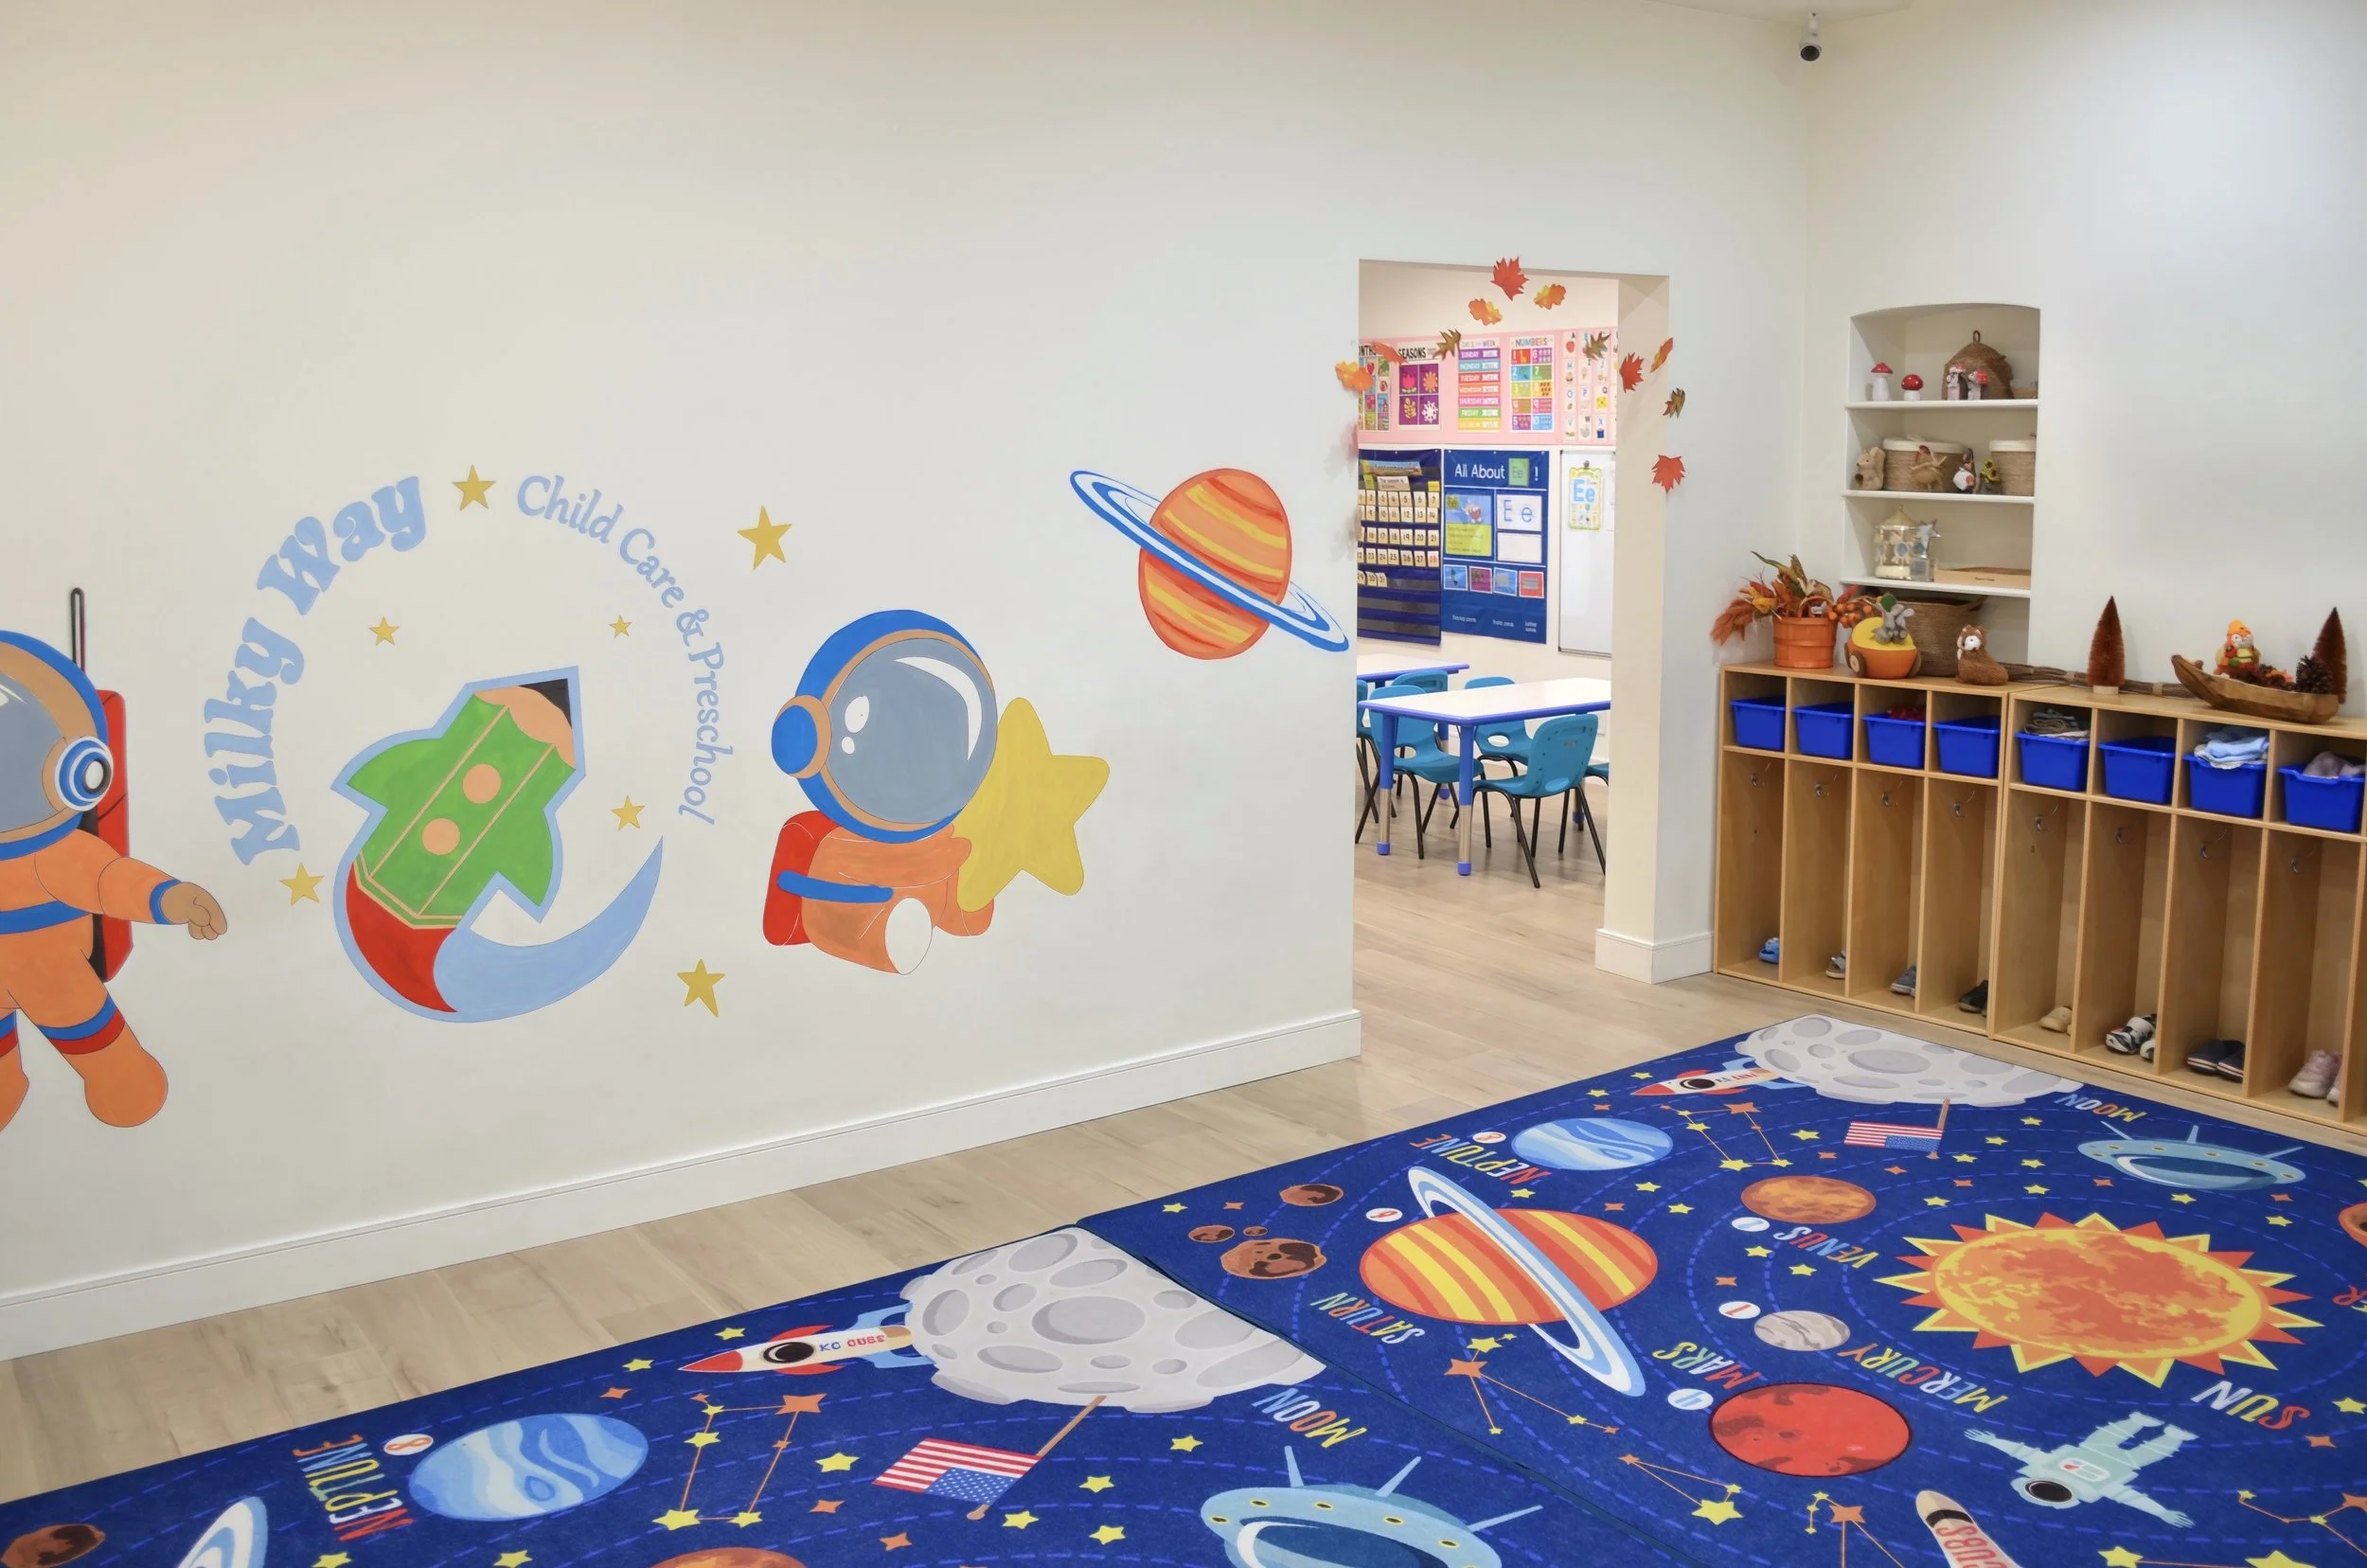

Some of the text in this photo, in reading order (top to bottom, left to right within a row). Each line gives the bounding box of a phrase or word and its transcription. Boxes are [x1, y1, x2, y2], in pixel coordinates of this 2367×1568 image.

[1398, 347, 1426, 359] SEASONS
[1515, 338, 1548, 347] NUMBERS
[1454, 464, 1505, 479] All About
[1574, 479, 1595, 502] Ee
[1504, 500, 1532, 523] E e
[203, 476, 427, 866] Milky Way
[516, 474, 734, 826] Child Care & Preschool
[2053, 1094, 2148, 1122] MOON
[1409, 1133, 1553, 1185] NEPTUNE
[1773, 1226, 1879, 1269] VENUS
[1310, 1292, 1426, 1344] SATURN
[1652, 1342, 1762, 1390] MARS
[1837, 1343, 2009, 1413] MERCURY
[1251, 1388, 1367, 1448] MOON
[2190, 1380, 2311, 1429] SUN
[292, 1434, 414, 1542] NEPTUNE
